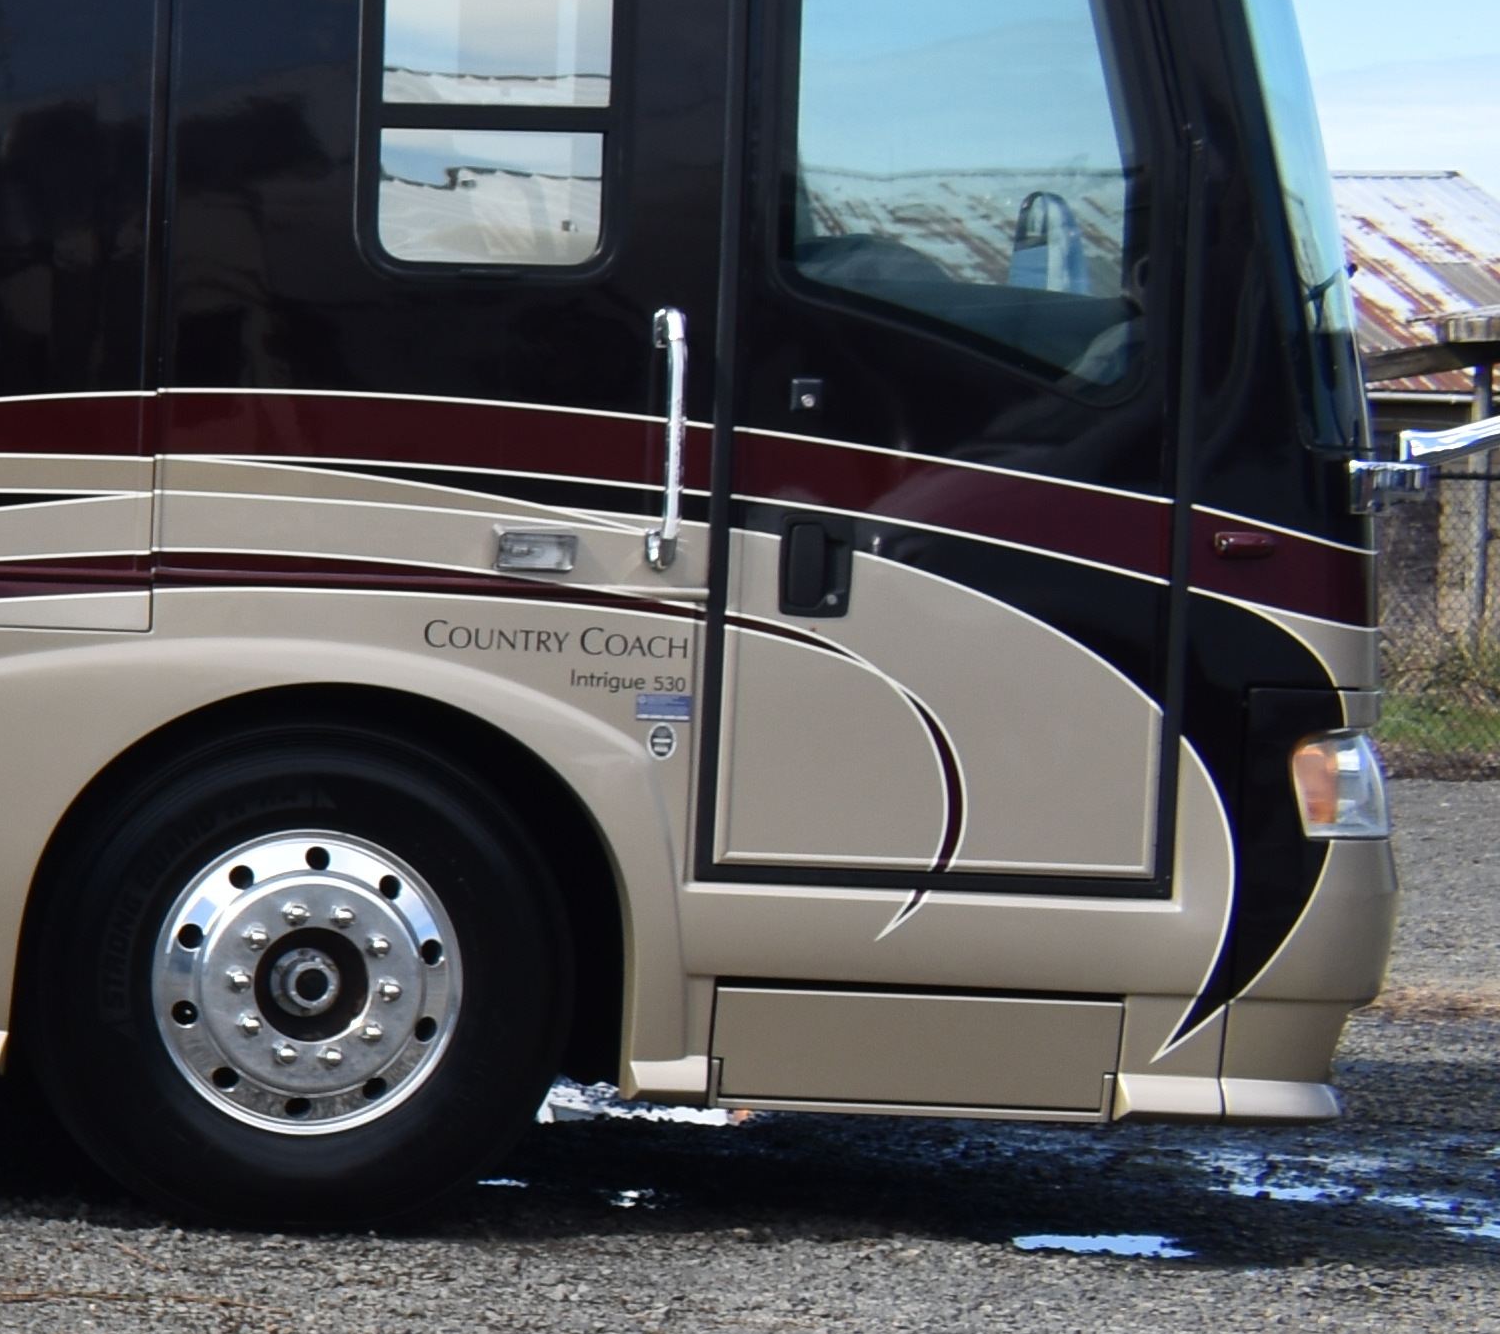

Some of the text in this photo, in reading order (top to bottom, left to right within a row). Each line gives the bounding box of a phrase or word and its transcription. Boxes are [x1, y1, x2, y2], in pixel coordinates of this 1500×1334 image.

[424, 619, 688, 659] COUNTRY COACH
[570, 669, 686, 694] Intrigue 530
[102, 891, 143, 1009] STRONG
